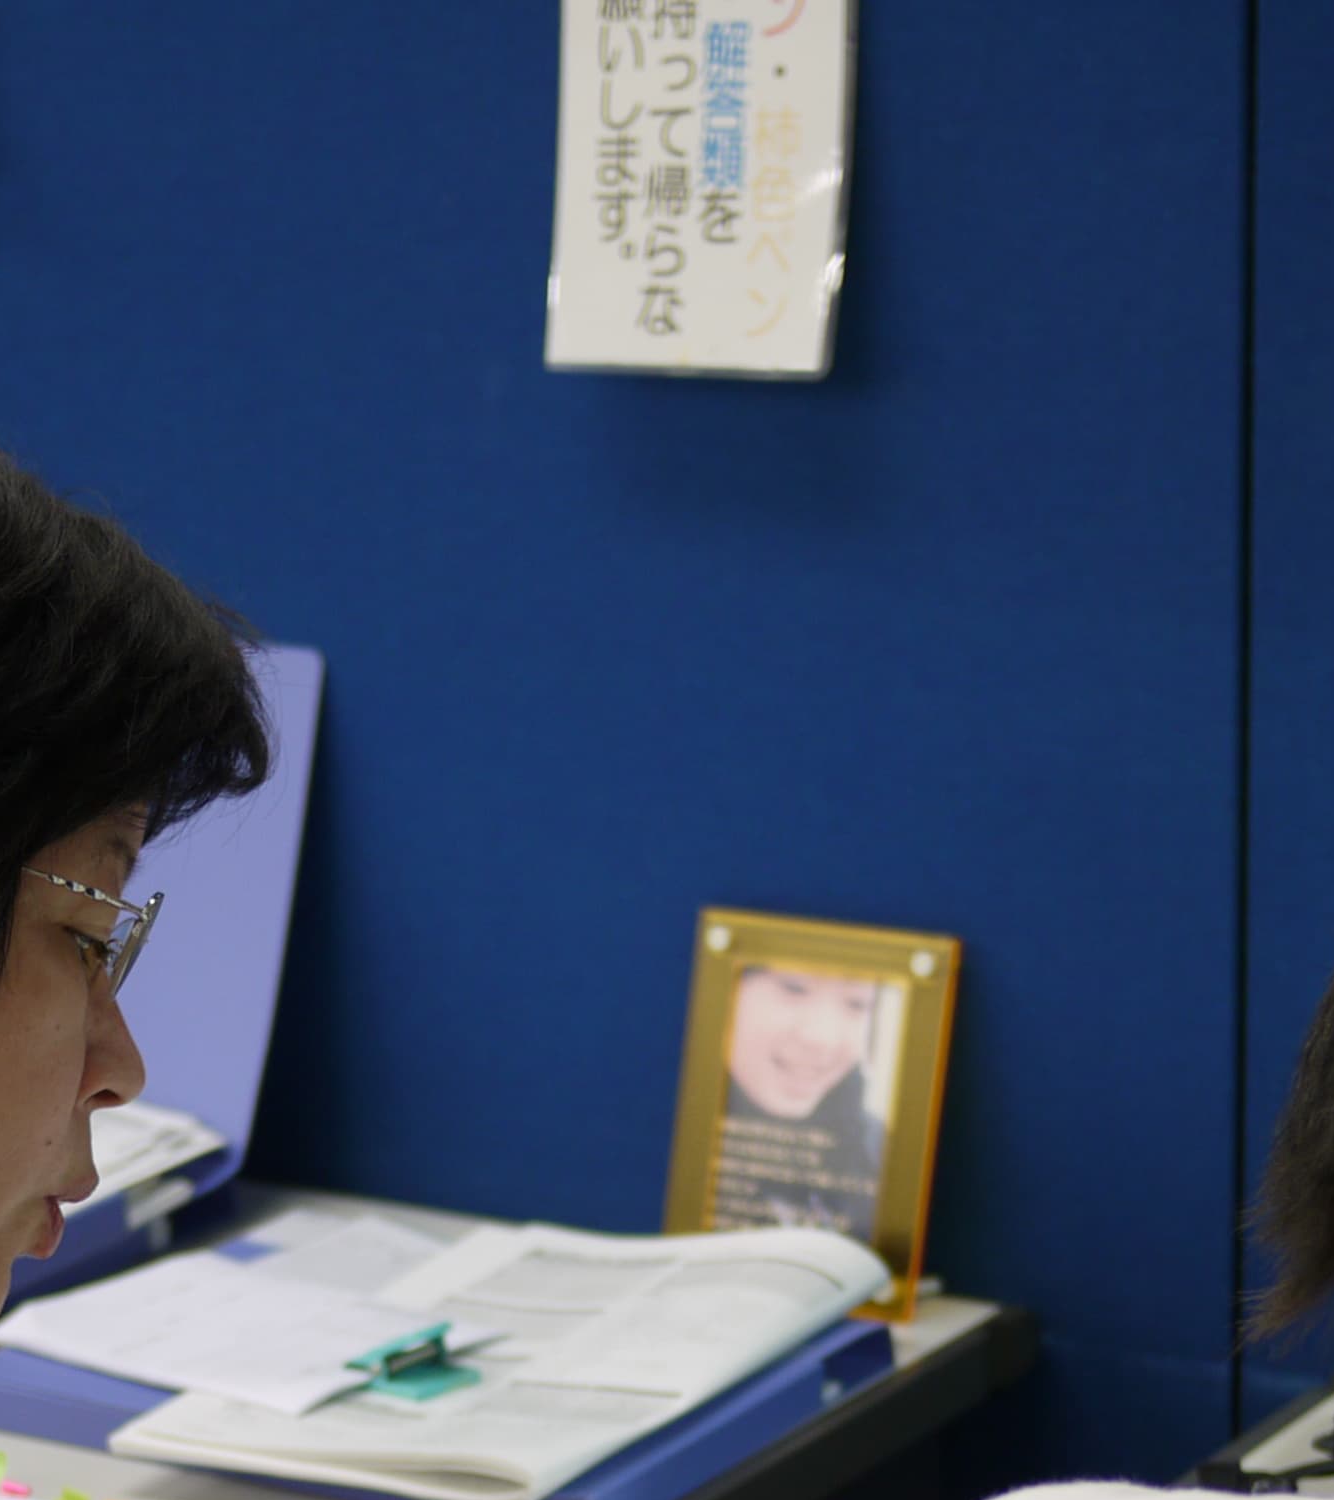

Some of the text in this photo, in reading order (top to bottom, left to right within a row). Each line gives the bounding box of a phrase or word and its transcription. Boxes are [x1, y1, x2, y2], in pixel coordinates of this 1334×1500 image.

[636, 0, 698, 337] 持って帰らな
